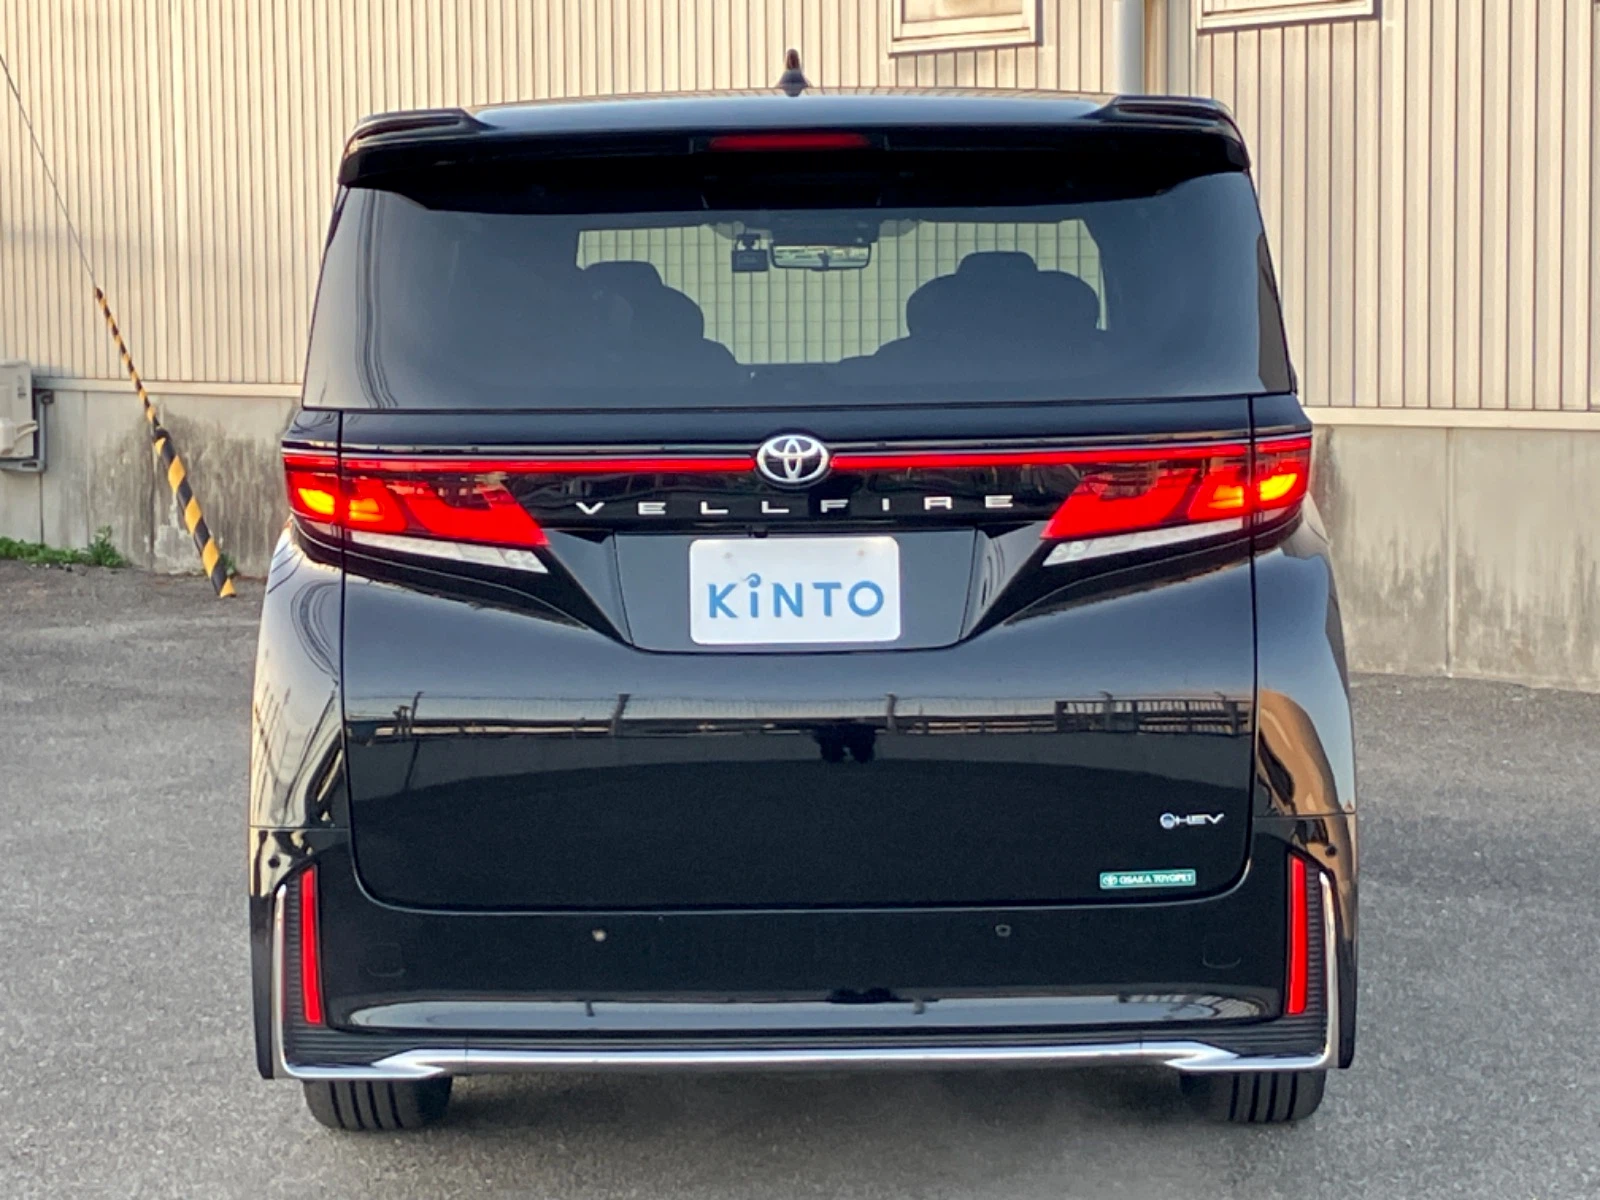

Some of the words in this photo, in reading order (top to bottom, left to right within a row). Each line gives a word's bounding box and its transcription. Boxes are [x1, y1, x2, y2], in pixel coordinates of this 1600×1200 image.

[576, 494, 1013, 516] VELLFIRE
[1175, 813, 1225, 825] HEV
[1119, 875, 1152, 885] OSAKA
[1153, 873, 1192, 883] TOYOPET
